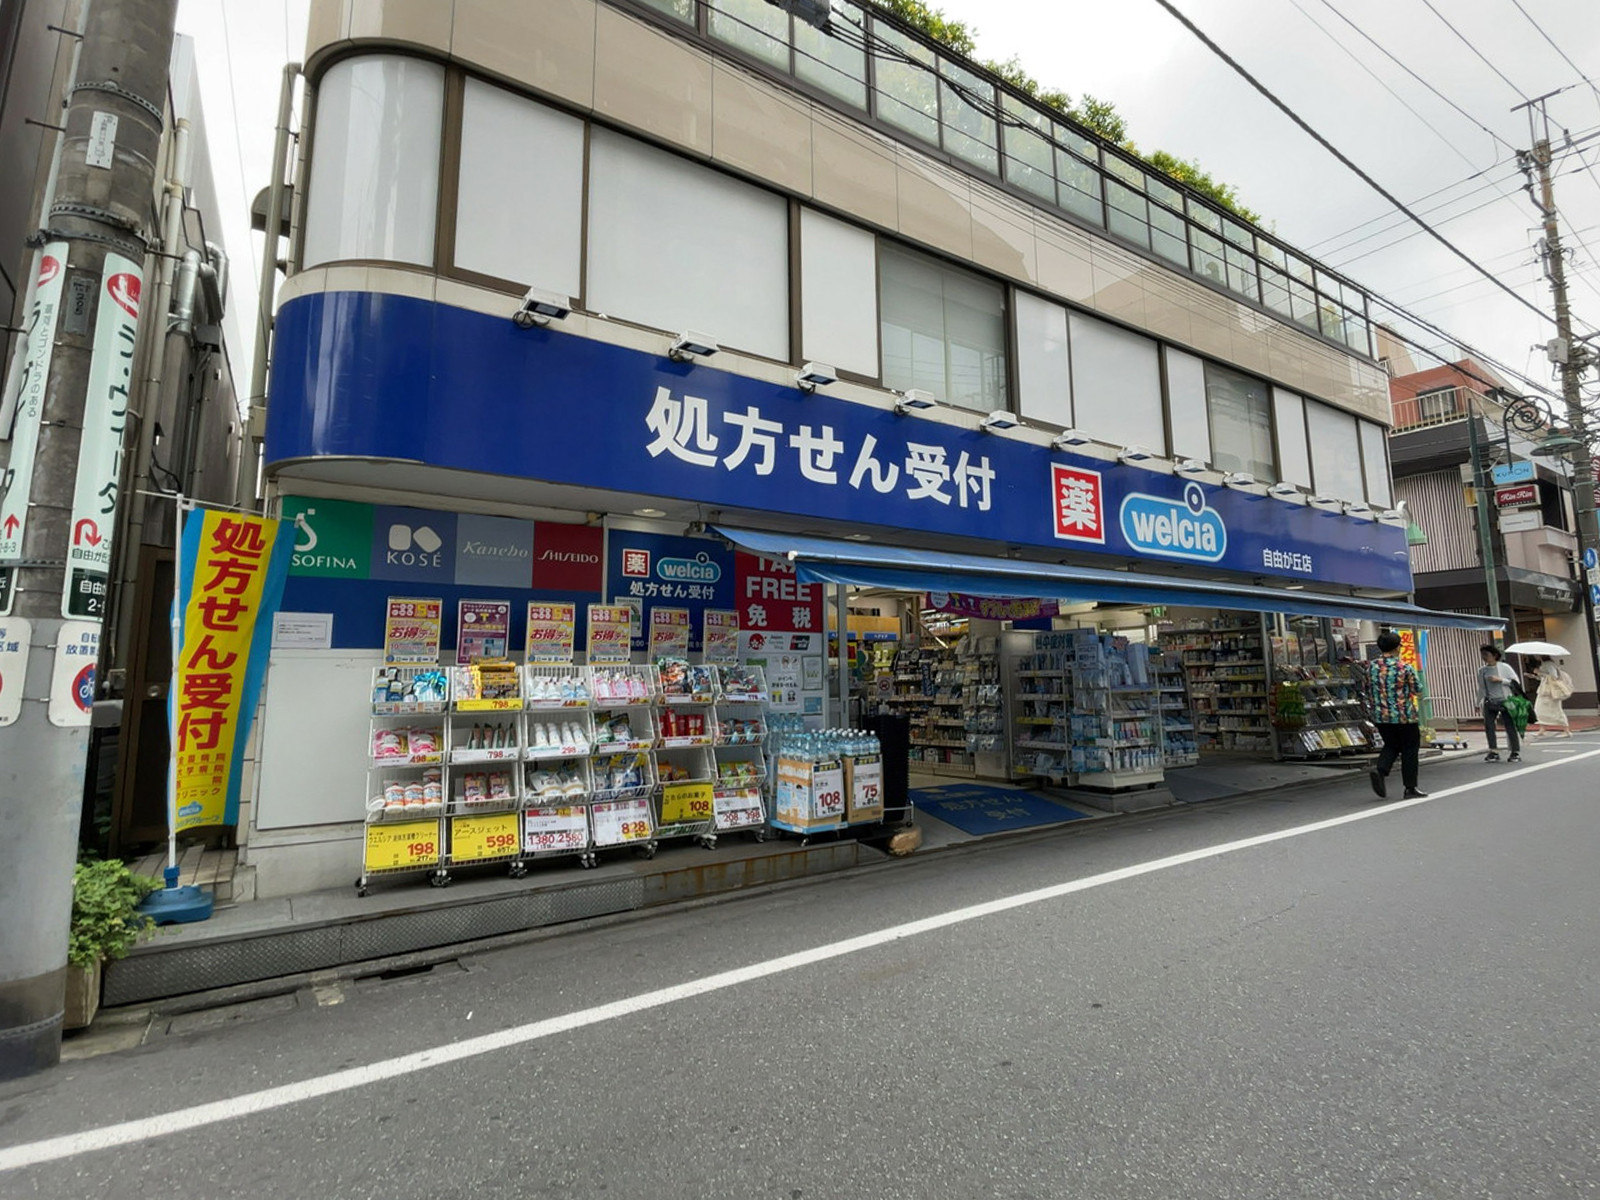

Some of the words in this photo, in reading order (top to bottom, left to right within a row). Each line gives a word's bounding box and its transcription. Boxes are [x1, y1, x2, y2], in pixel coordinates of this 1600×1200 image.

[645, 386, 995, 511] 処方せん受付
[1060, 476, 1097, 531] 薬
[1131, 508, 1216, 552] welcia
[463, 541, 528, 558] Kanebo
[537, 549, 599, 564] SHISEIDO
[292, 554, 357, 570] SOFINA
[387, 552, 442, 568] KOSÉ
[627, 553, 646, 573] 薬
[1262, 548, 1312, 573] 自由が丘店
[663, 560, 714, 580] welcia
[630, 581, 715, 599] 処方せん受付
[746, 576, 812, 602] FREE
[178, 518, 266, 752] 処方せん受付
[819, 790, 841, 807] 108
[863, 784, 878, 798] 75
[689, 801, 709, 812] 108
[454, 824, 508, 836] アースジェット
[621, 820, 646, 834] 828
[486, 833, 515, 848] 598
[529, 833, 555, 845] 1380
[407, 842, 434, 856] 198
